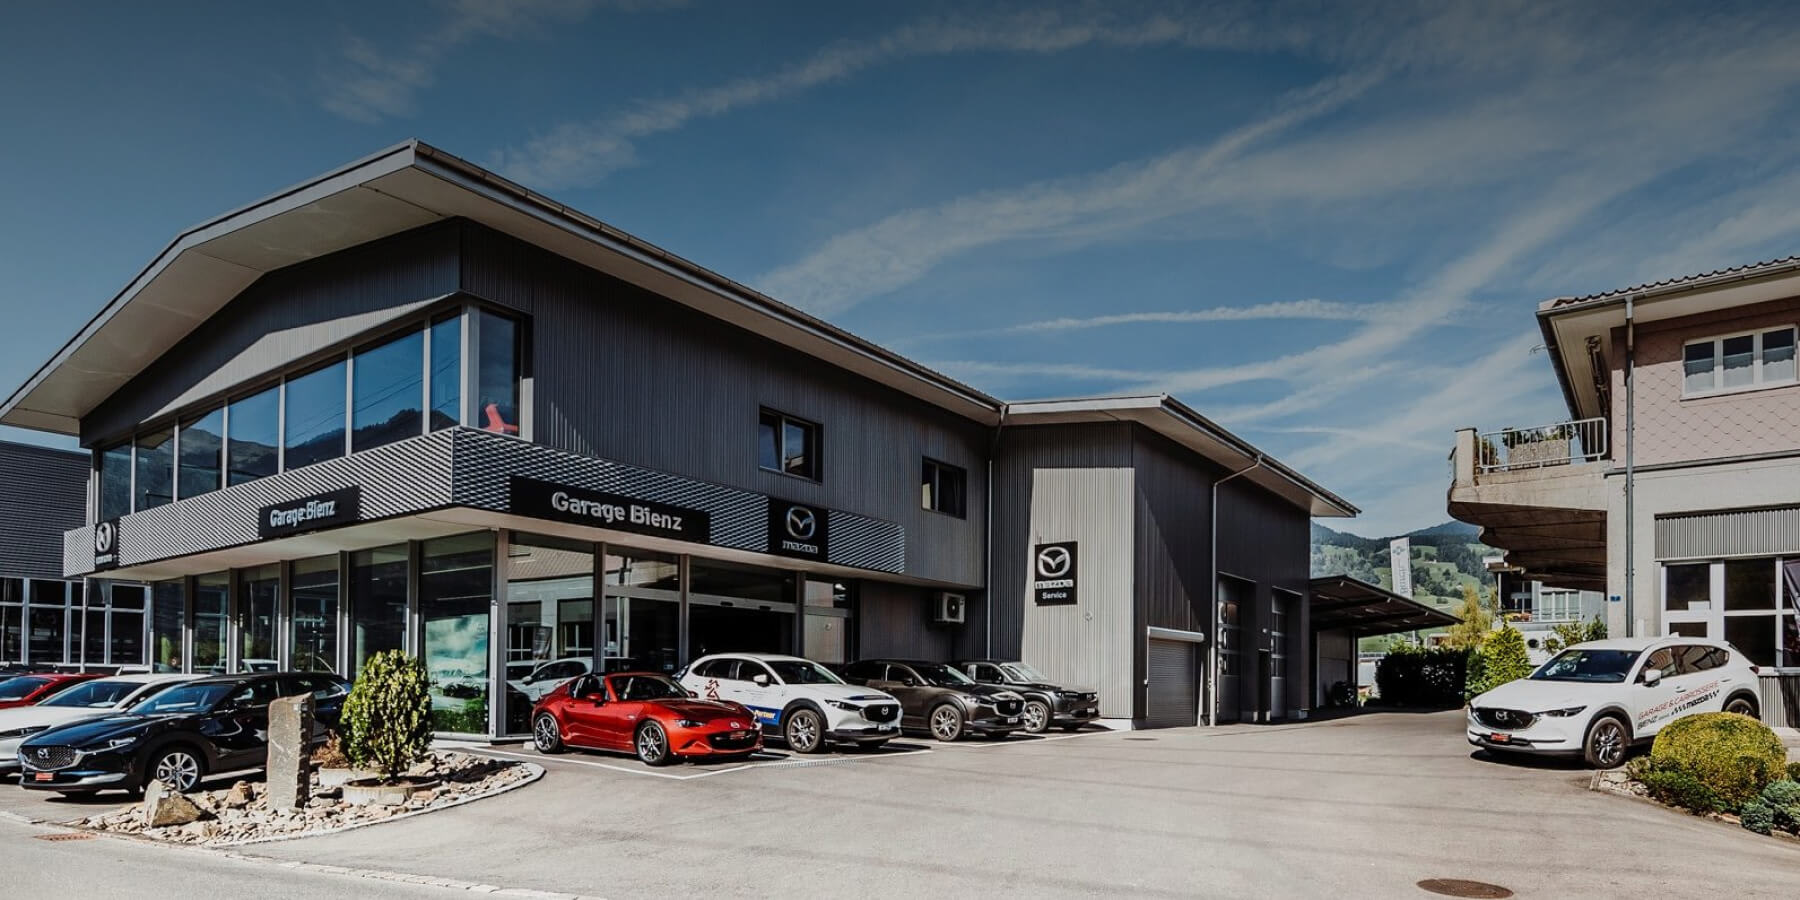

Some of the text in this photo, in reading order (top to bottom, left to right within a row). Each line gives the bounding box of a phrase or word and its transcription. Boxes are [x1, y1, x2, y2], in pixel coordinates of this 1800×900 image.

[270, 508, 305, 527] Garage
[552, 492, 682, 530] Garage Bienz
[782, 541, 818, 554] mazda
[1639, 701, 1668, 720] GARAGE
